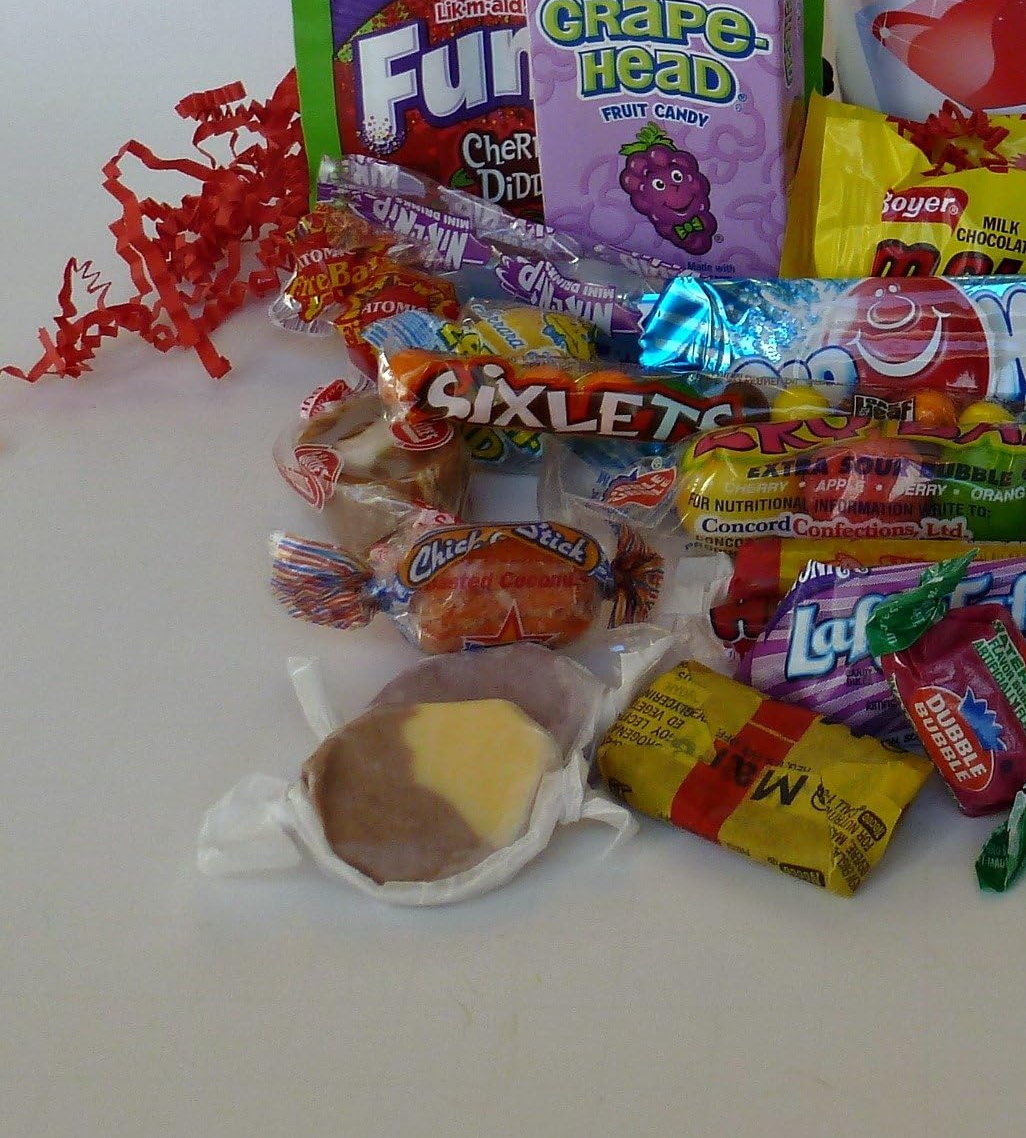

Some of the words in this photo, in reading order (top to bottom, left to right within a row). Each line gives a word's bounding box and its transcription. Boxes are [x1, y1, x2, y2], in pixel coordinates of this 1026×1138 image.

[600, 103, 648, 123] FRUIT
[653, 104, 709, 126] CANDY
[462, 132, 540, 169] CheR
[442, 214, 470, 229] MINI
[982, 216, 1021, 235] MILK
[746, 456, 829, 480] EXTRA
[723, 479, 788, 495] CHERRY
[814, 478, 866, 494] APPLE
[893, 481, 949, 501] ERRY
[714, 495, 804, 514] NUTRITIONAL
[702, 515, 791, 536] Concord
[792, 518, 919, 541] Confections,
[926, 521, 969, 539] Ltd.
[409, 529, 481, 583] Chick
[987, 636, 1016, 683] FLAVOR
[974, 639, 1021, 708] ARTIFICIALLY
[914, 701, 972, 783] BUBBLE
[925, 693, 988, 778] DUBBLE
